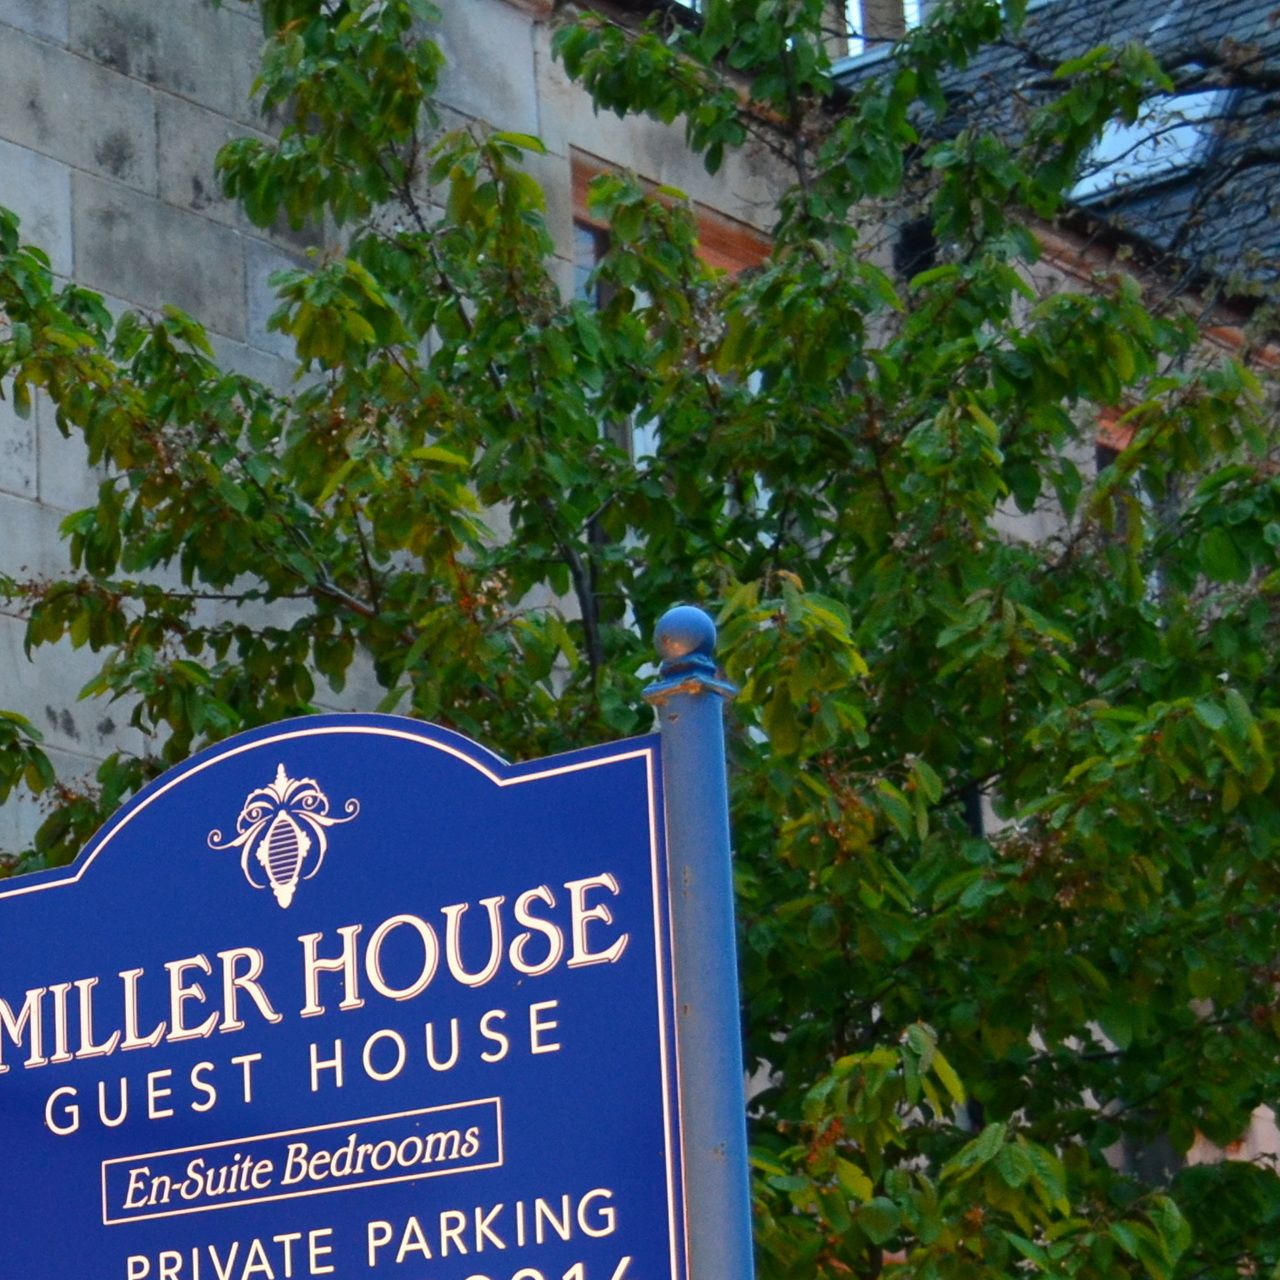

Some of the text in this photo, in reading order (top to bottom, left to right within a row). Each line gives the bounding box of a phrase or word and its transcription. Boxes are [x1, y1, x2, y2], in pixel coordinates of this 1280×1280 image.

[297, 872, 629, 1019] HOUSE
[45, 999, 562, 1136] GUEST HOUSE
[122, 1126, 481, 1210] En-Suite Bedrooms
[367, 1188, 616, 1268] PARKING
